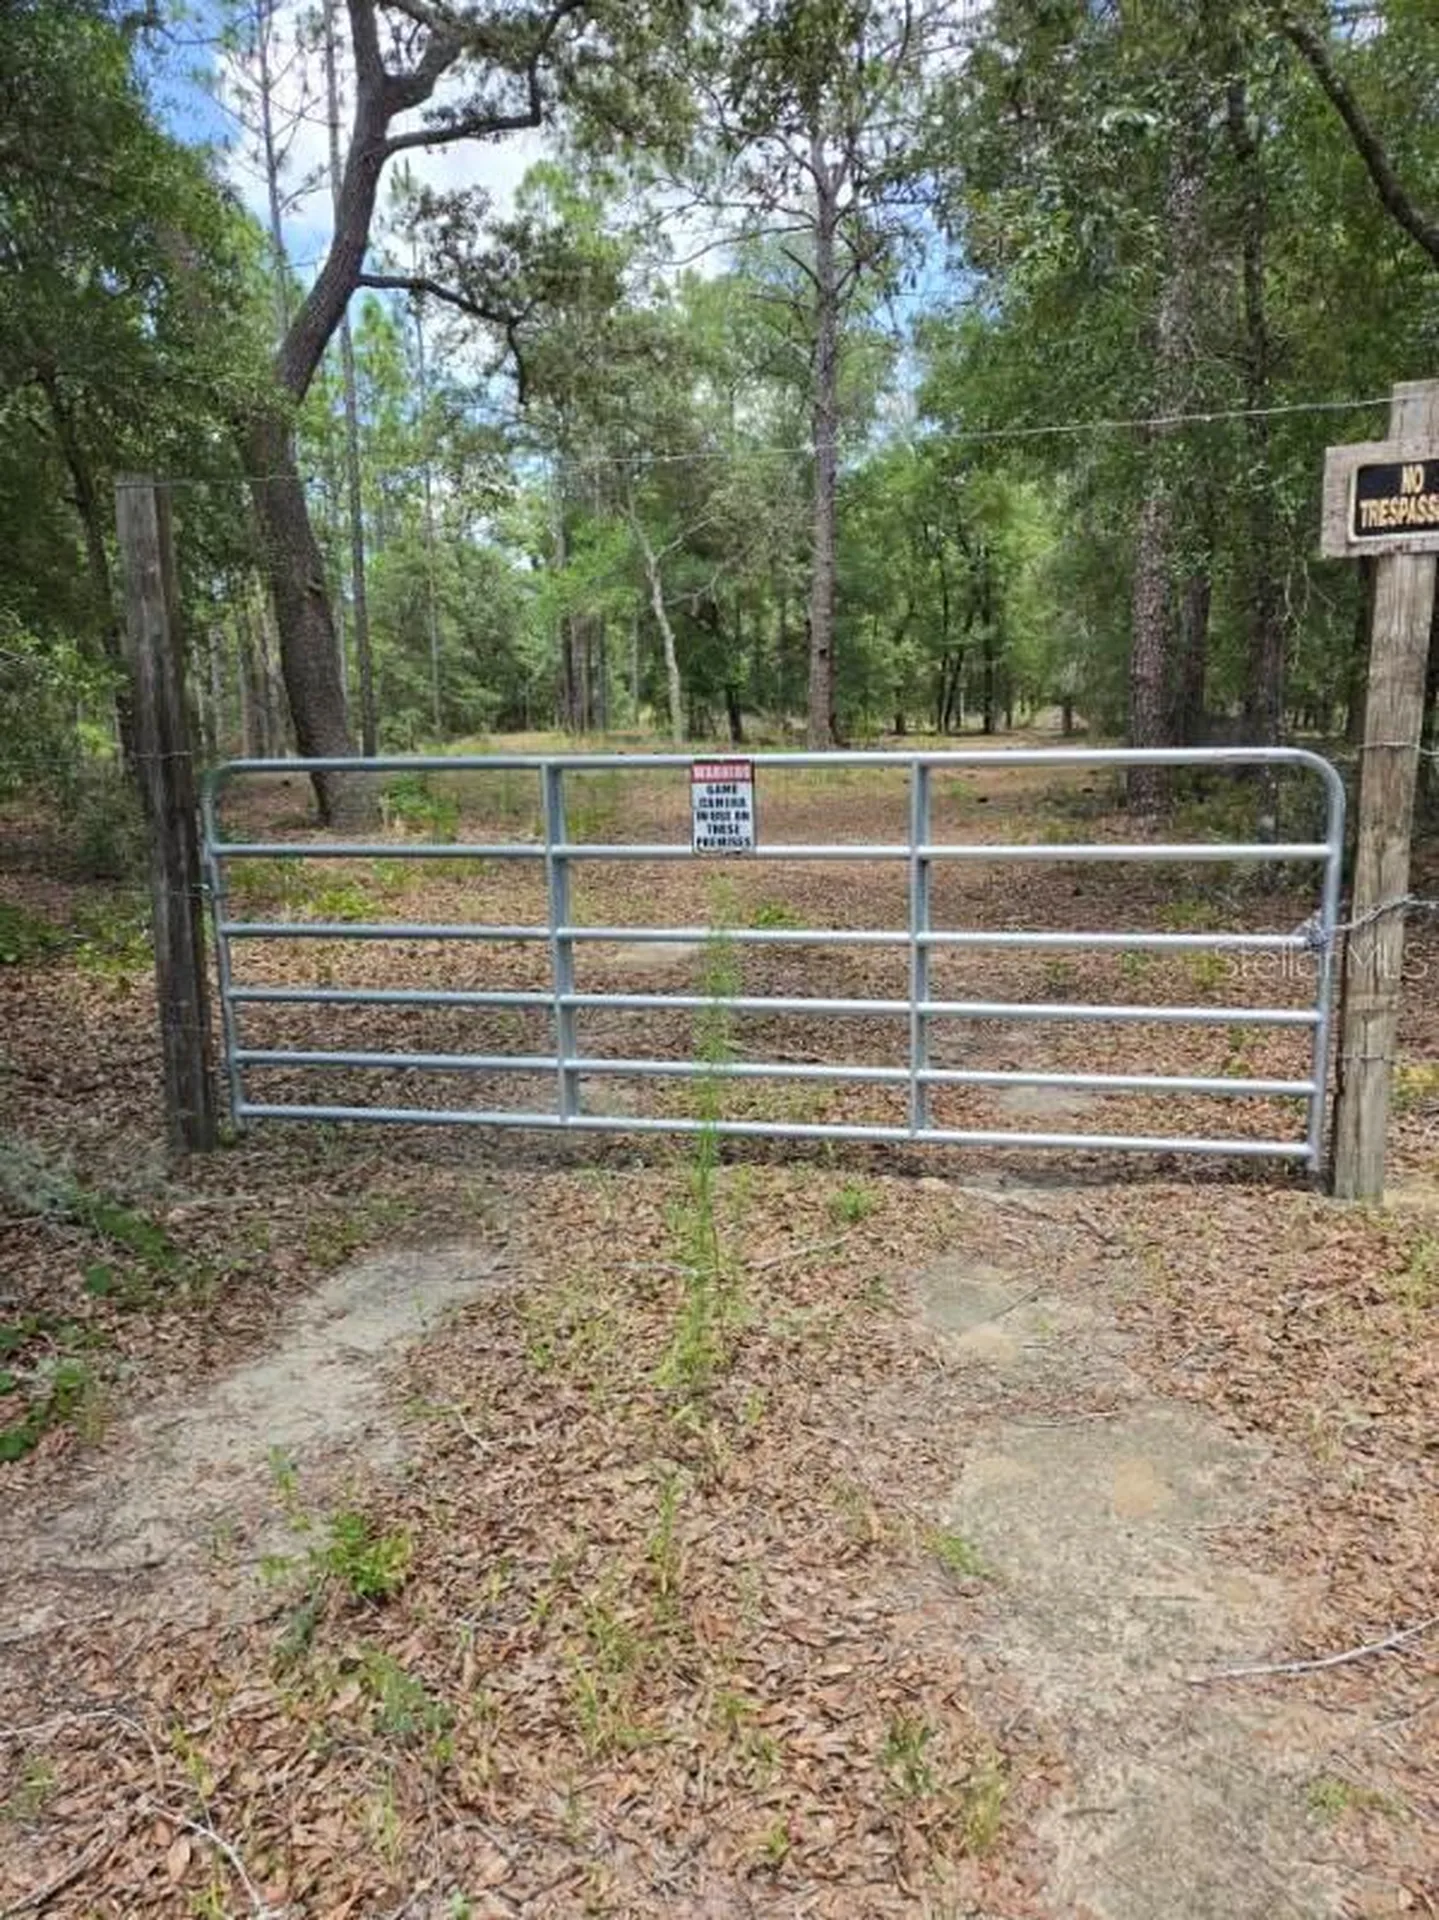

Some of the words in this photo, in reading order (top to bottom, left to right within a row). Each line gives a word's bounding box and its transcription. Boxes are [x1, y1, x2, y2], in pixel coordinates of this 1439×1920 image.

[1401, 463, 1424, 494] NO
[706, 785, 737, 794] GAME
[707, 824, 739, 834] THESE
[696, 837, 751, 847] PREMISES
